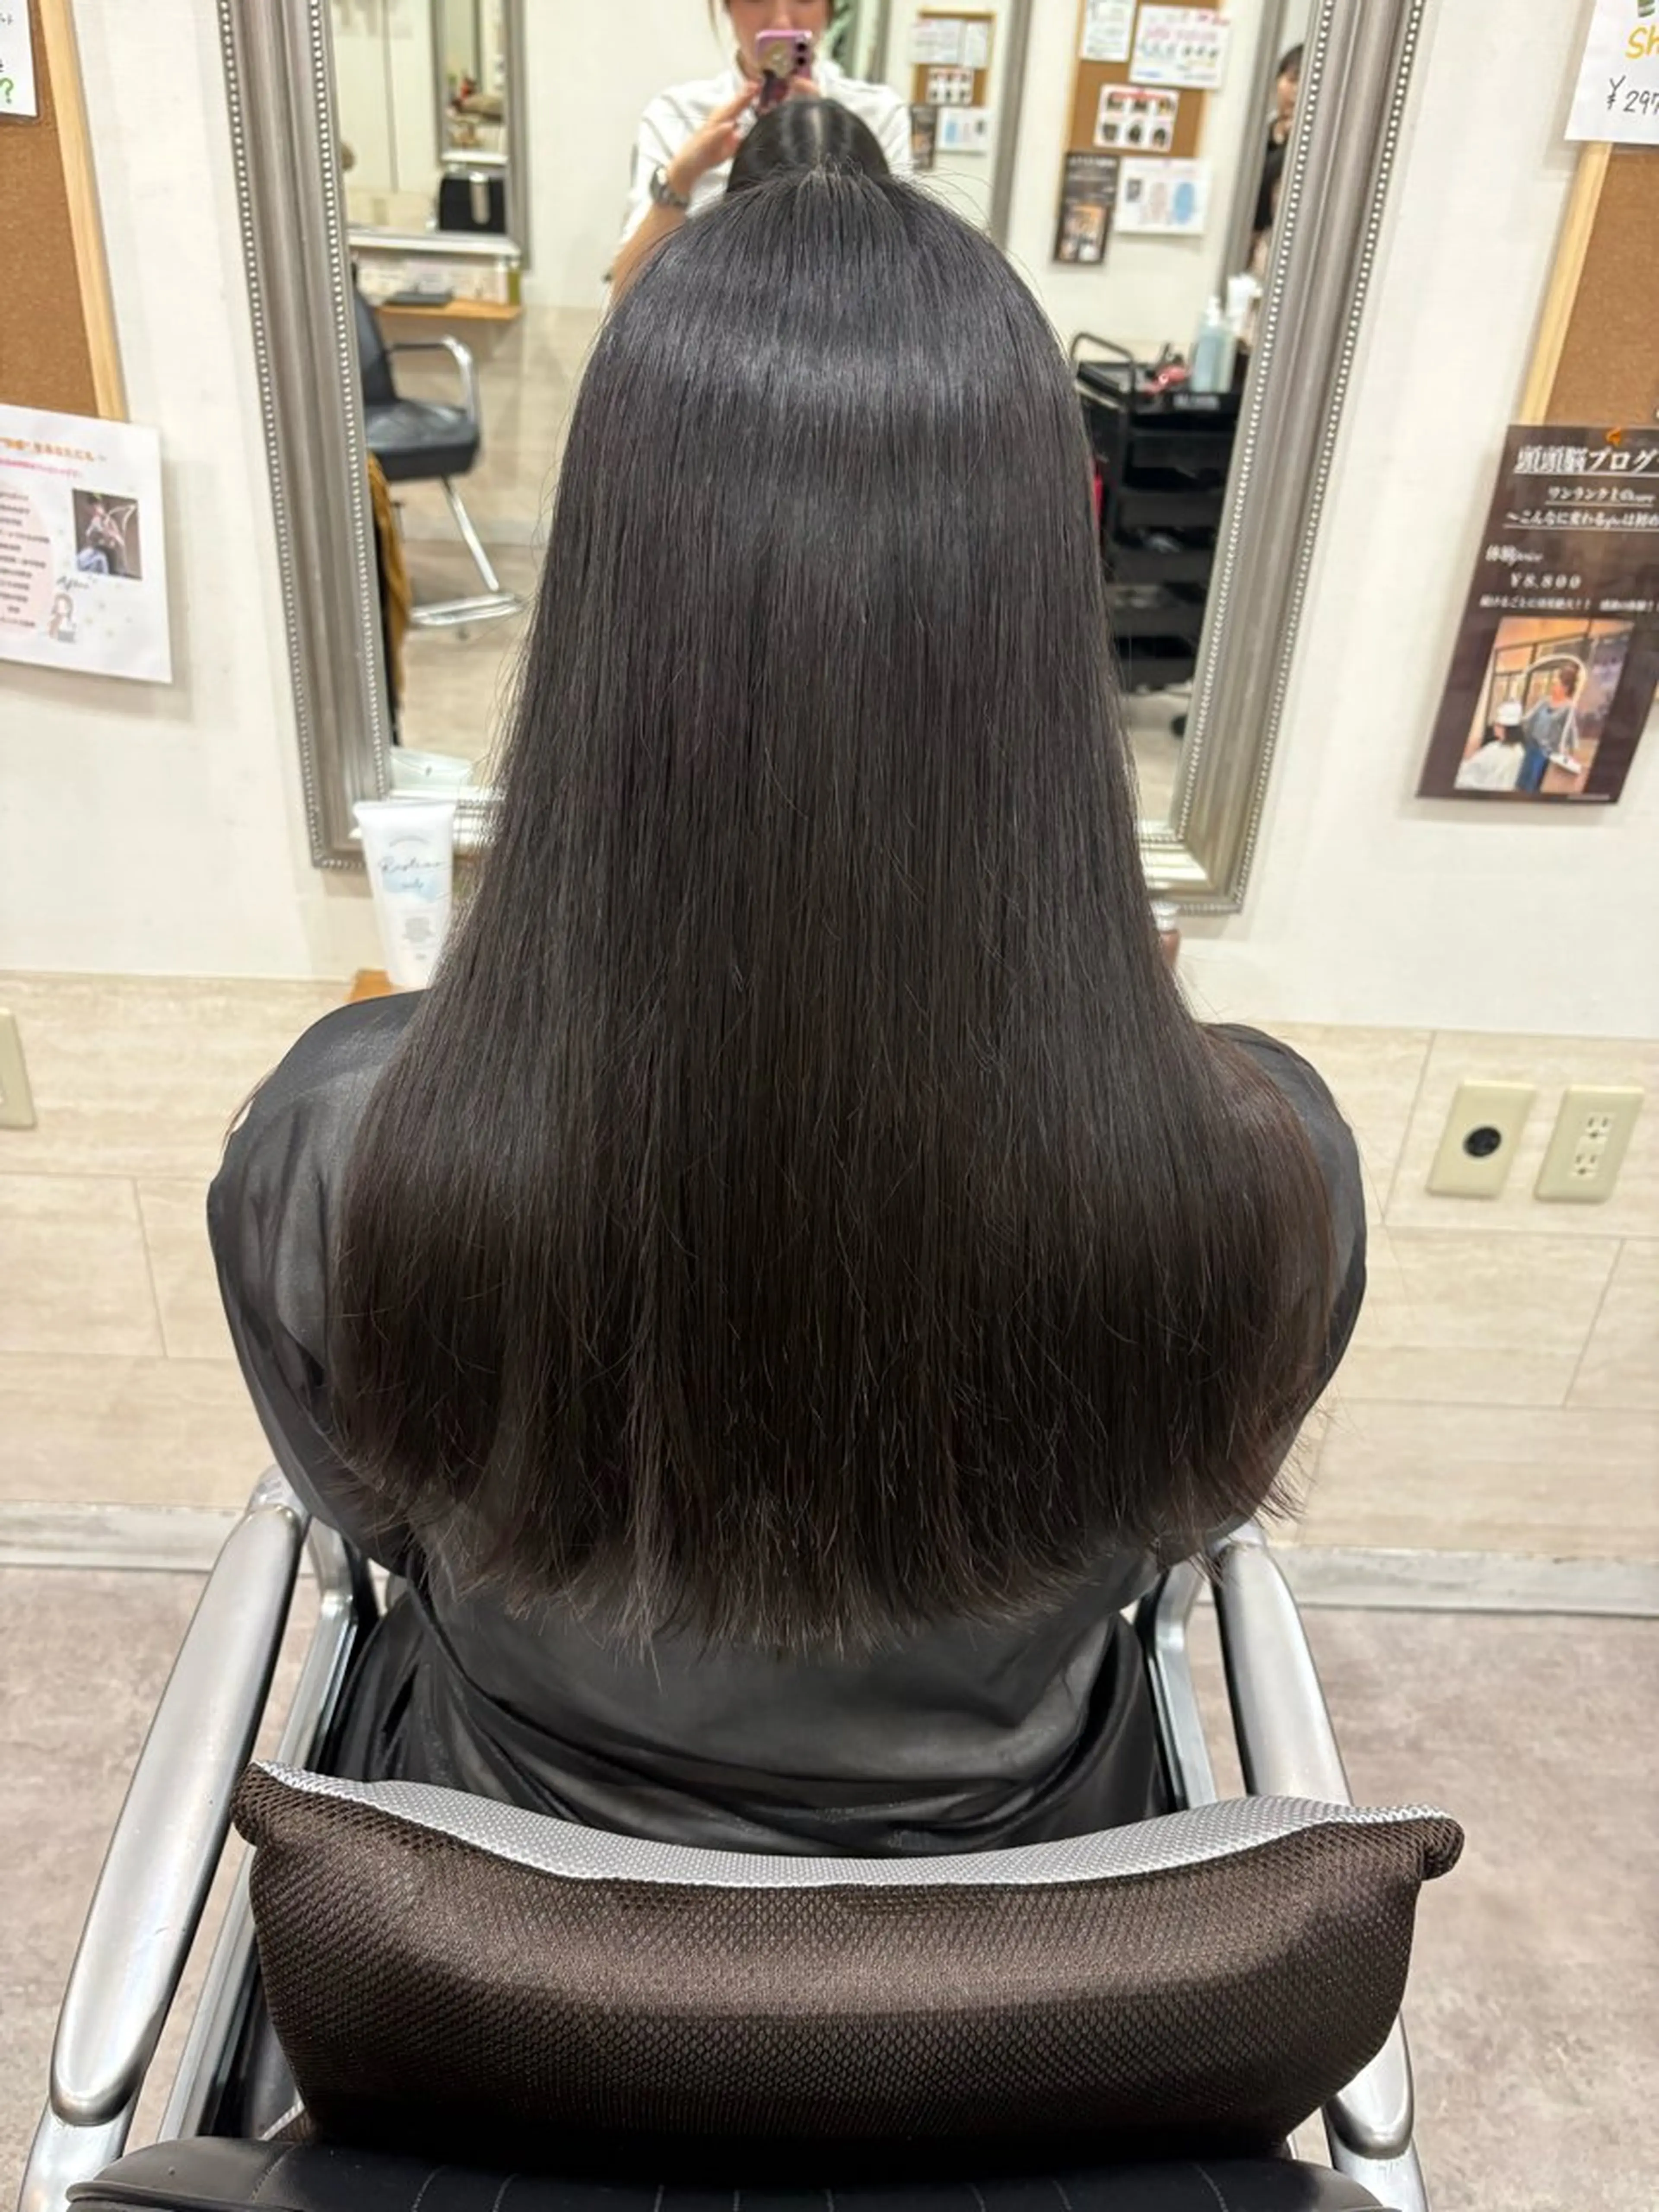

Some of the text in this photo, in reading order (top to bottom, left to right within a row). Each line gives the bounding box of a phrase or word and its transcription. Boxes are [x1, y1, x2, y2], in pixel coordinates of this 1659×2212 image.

[1514, 444, 1659, 473] 頭頭脳ブログ
